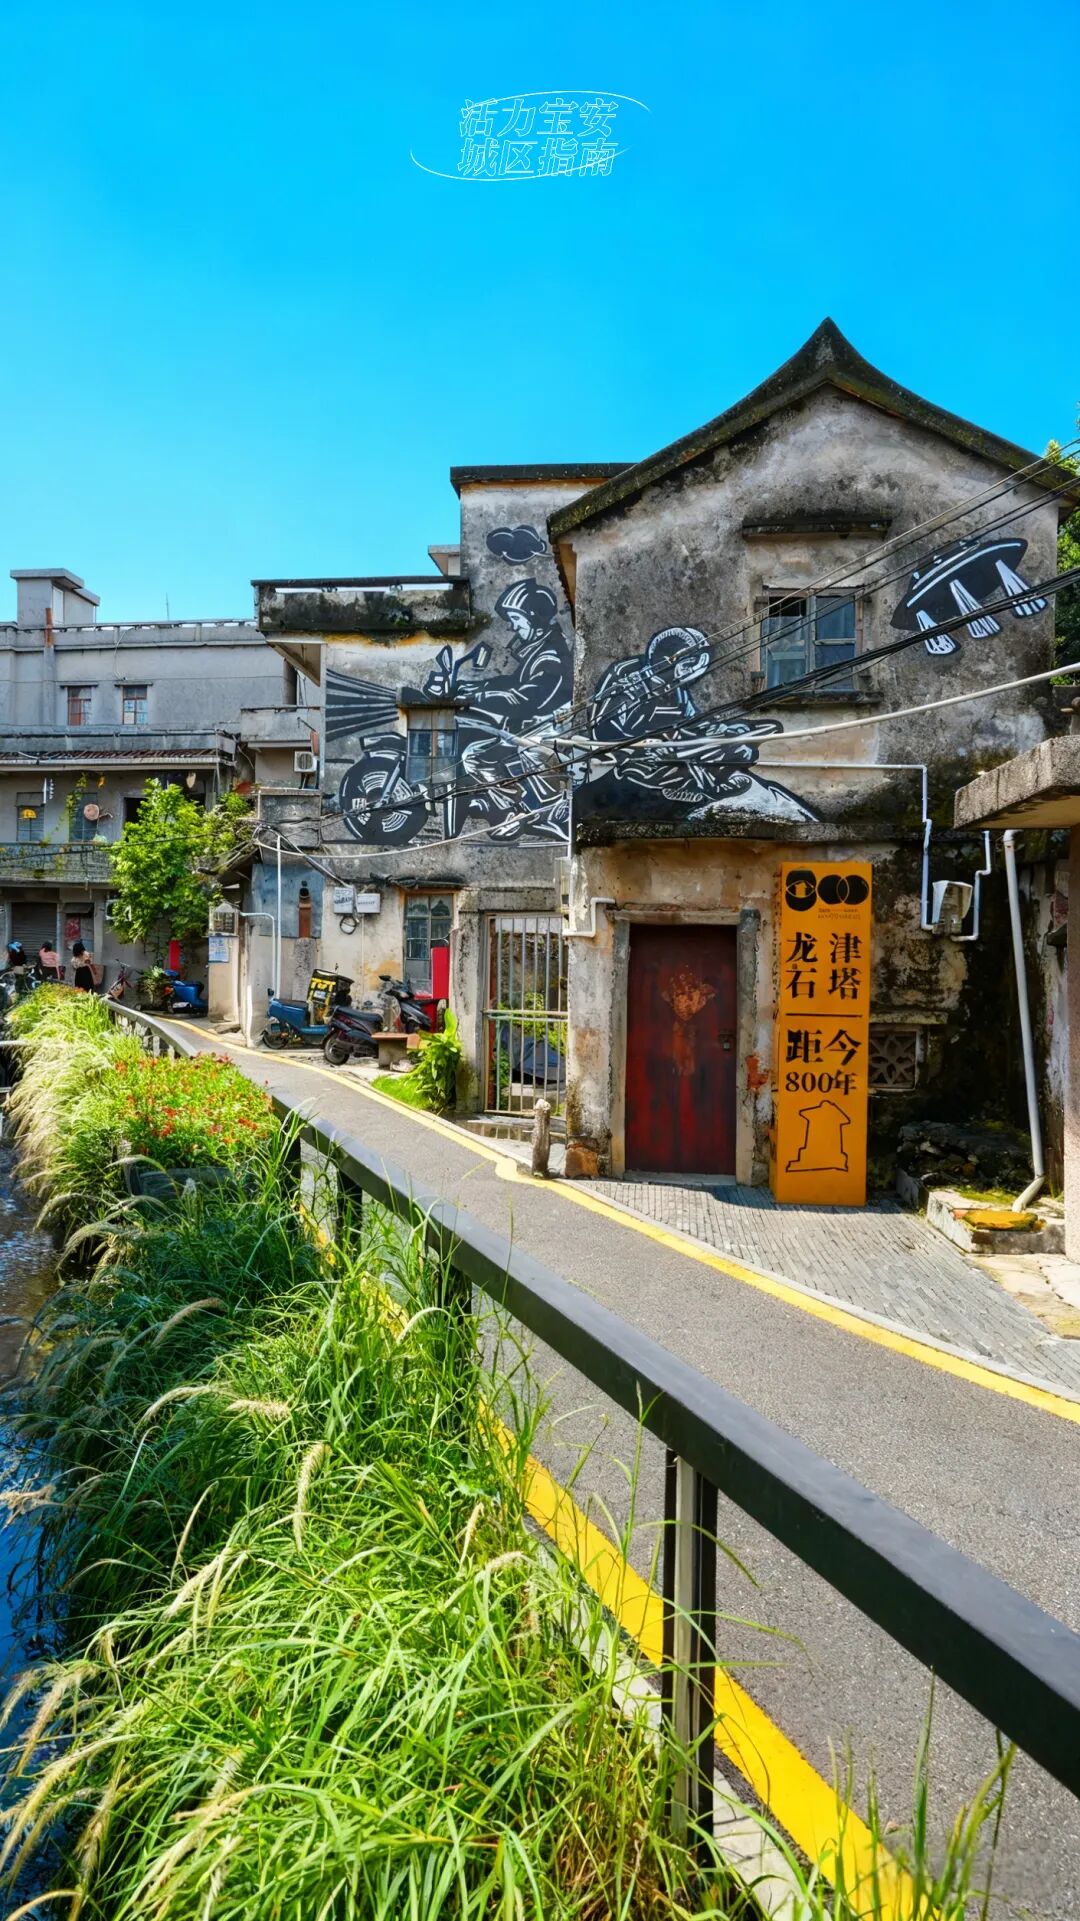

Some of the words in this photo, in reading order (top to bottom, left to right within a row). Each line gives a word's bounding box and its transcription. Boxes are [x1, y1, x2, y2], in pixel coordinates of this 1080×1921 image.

[786, 932, 862, 963] 龙津
[785, 967, 861, 999] 石塔
[786, 1029, 862, 1066] 距今
[785, 1069, 857, 1096] 800年
